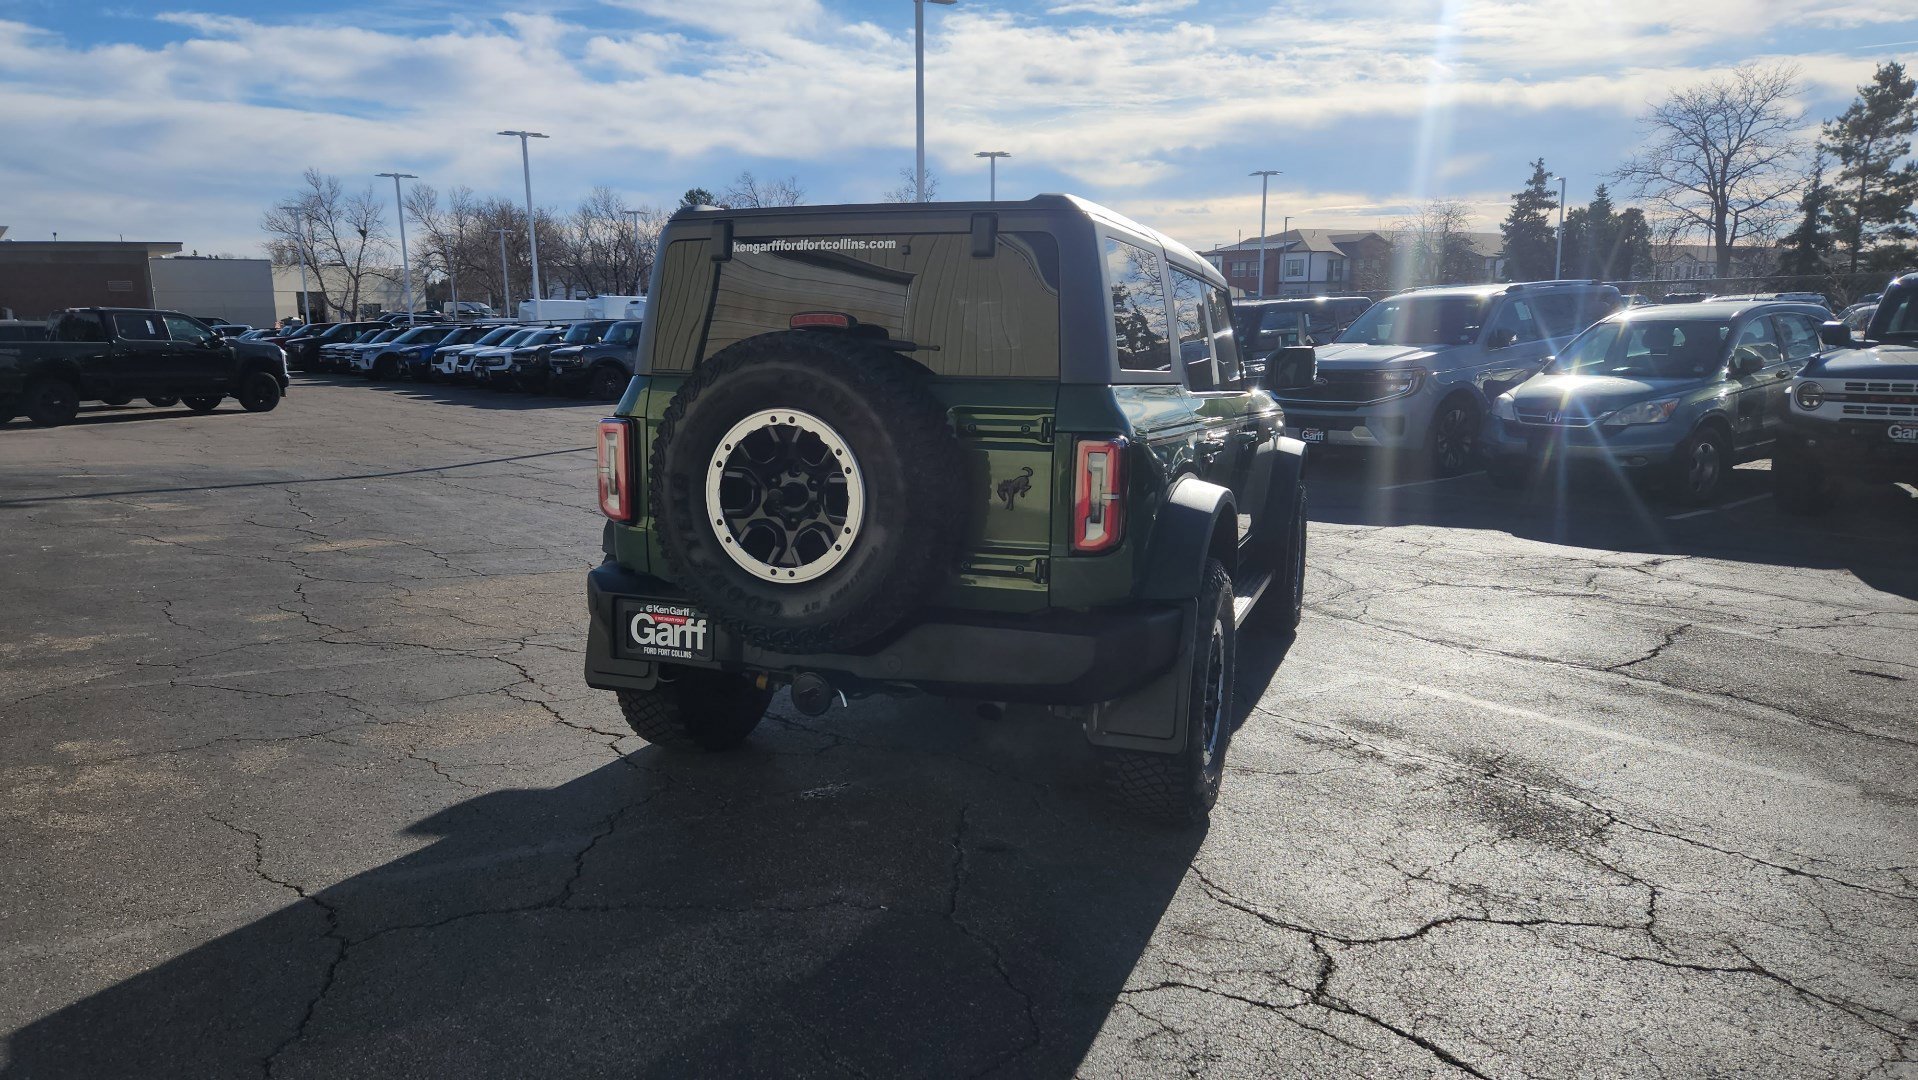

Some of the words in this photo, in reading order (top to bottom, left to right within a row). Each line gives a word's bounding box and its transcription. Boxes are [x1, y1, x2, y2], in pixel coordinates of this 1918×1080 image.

[733, 238, 897, 254] kengarfffordfortcollins.com
[1302, 430, 1324, 440] Garff
[630, 612, 706, 650] Garff
[643, 646, 657, 656] FORD
[657, 647, 671, 657] FORT
[671, 649, 692, 659] COLLINS
